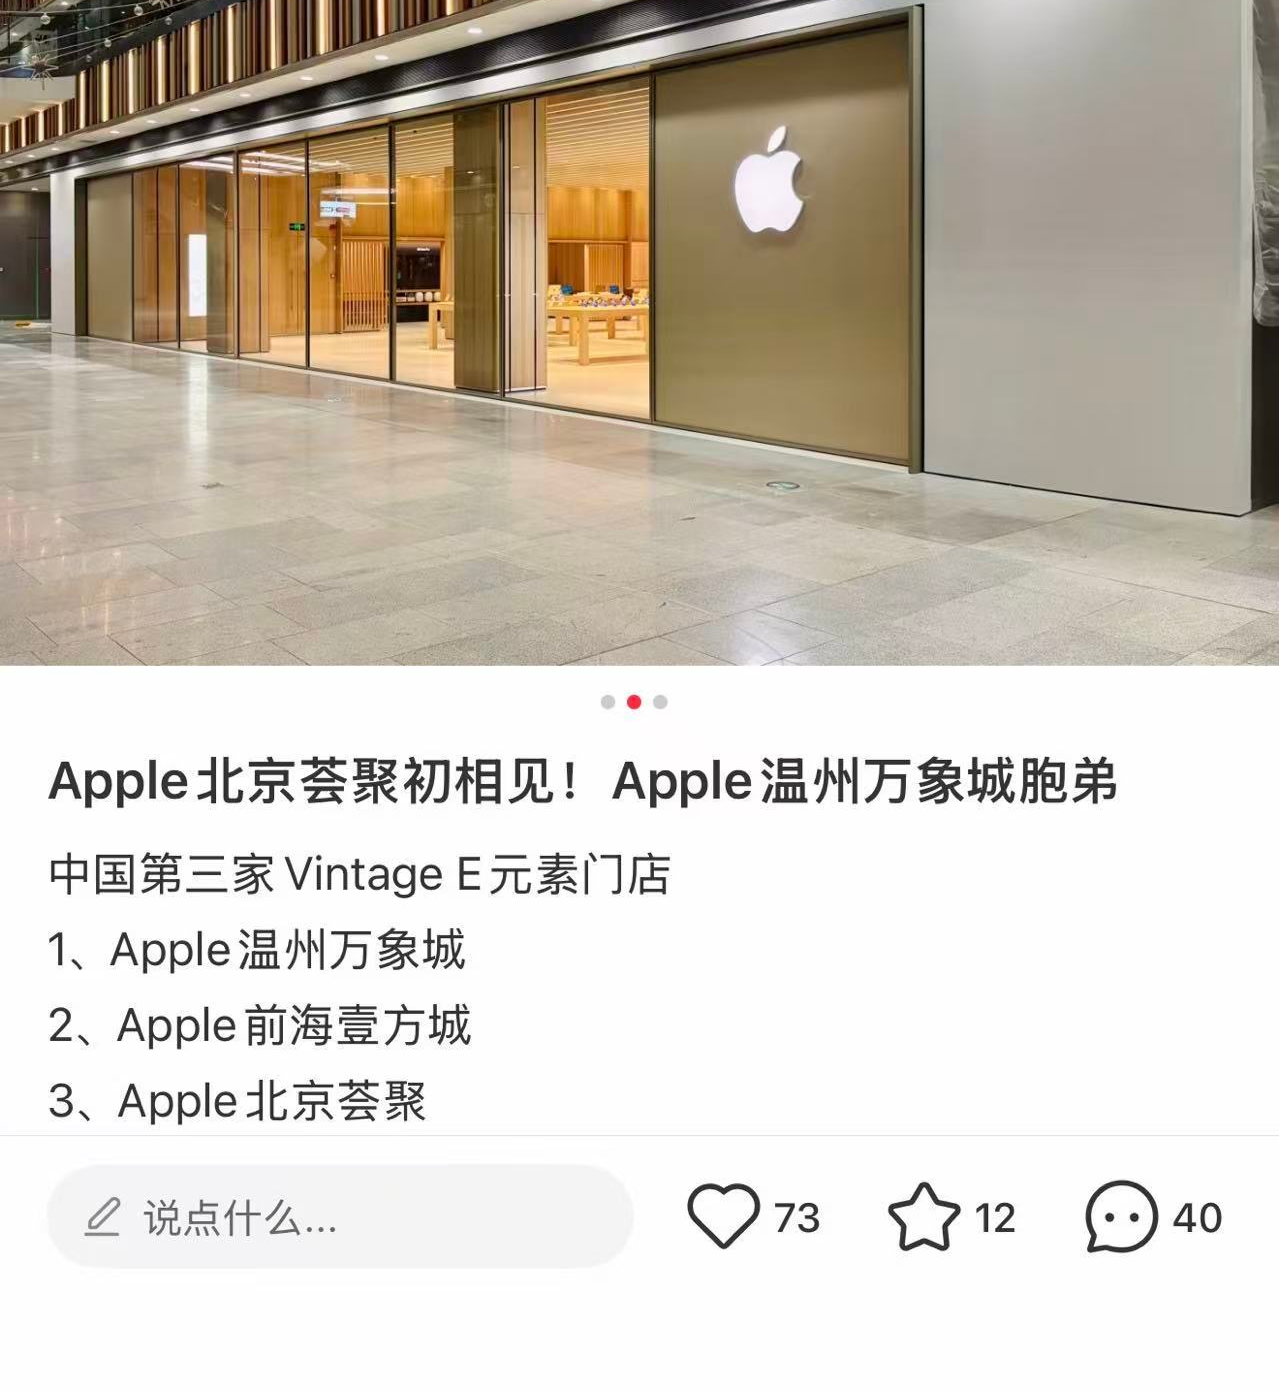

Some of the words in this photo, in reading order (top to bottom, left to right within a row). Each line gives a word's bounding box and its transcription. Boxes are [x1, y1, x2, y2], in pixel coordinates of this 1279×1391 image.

[774, 1202, 820, 1234] 73
[975, 1201, 1016, 1233] 12
[1172, 1201, 1223, 1234] 40
